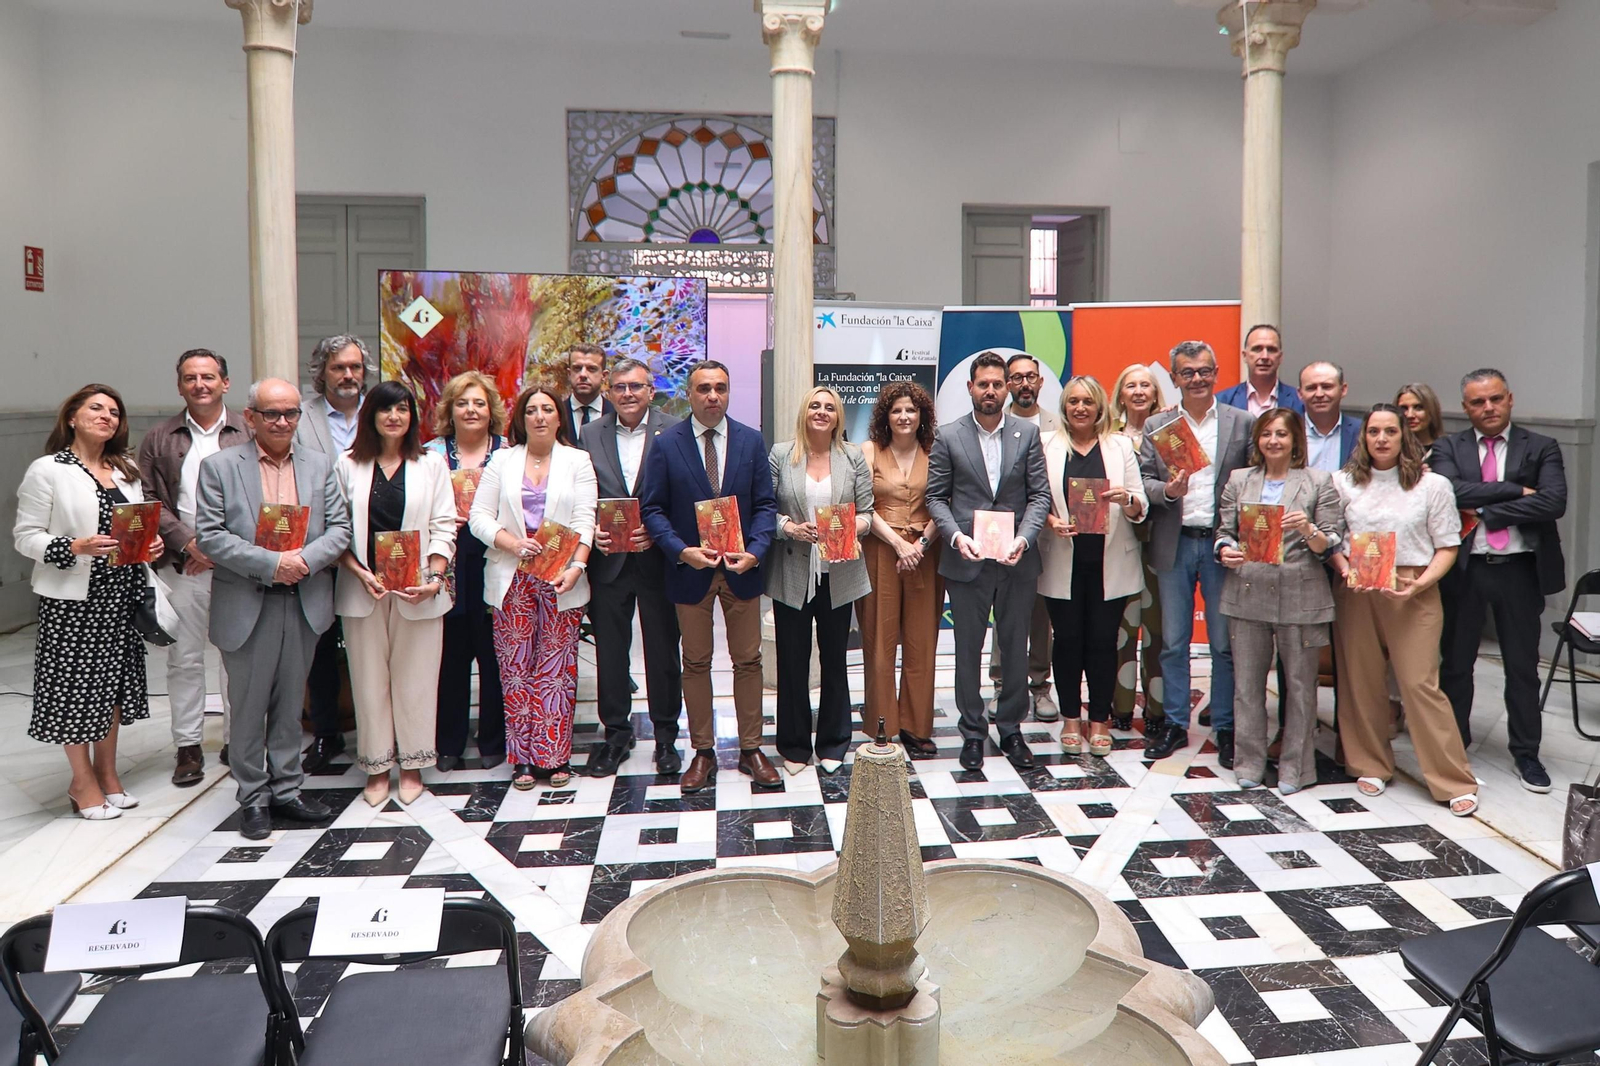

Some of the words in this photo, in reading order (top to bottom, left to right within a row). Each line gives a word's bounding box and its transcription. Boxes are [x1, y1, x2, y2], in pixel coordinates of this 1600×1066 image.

[841, 314, 891, 326] Fundación
[818, 372, 829, 382] La
[831, 372, 875, 382] Fundación
[856, 385, 872, 393] con
[873, 383, 881, 393] el
[847, 395, 857, 404] de
[858, 395, 878, 404] Gran
[350, 930, 400, 939] RESERVADO
[88, 941, 140, 952] RESERVADO
